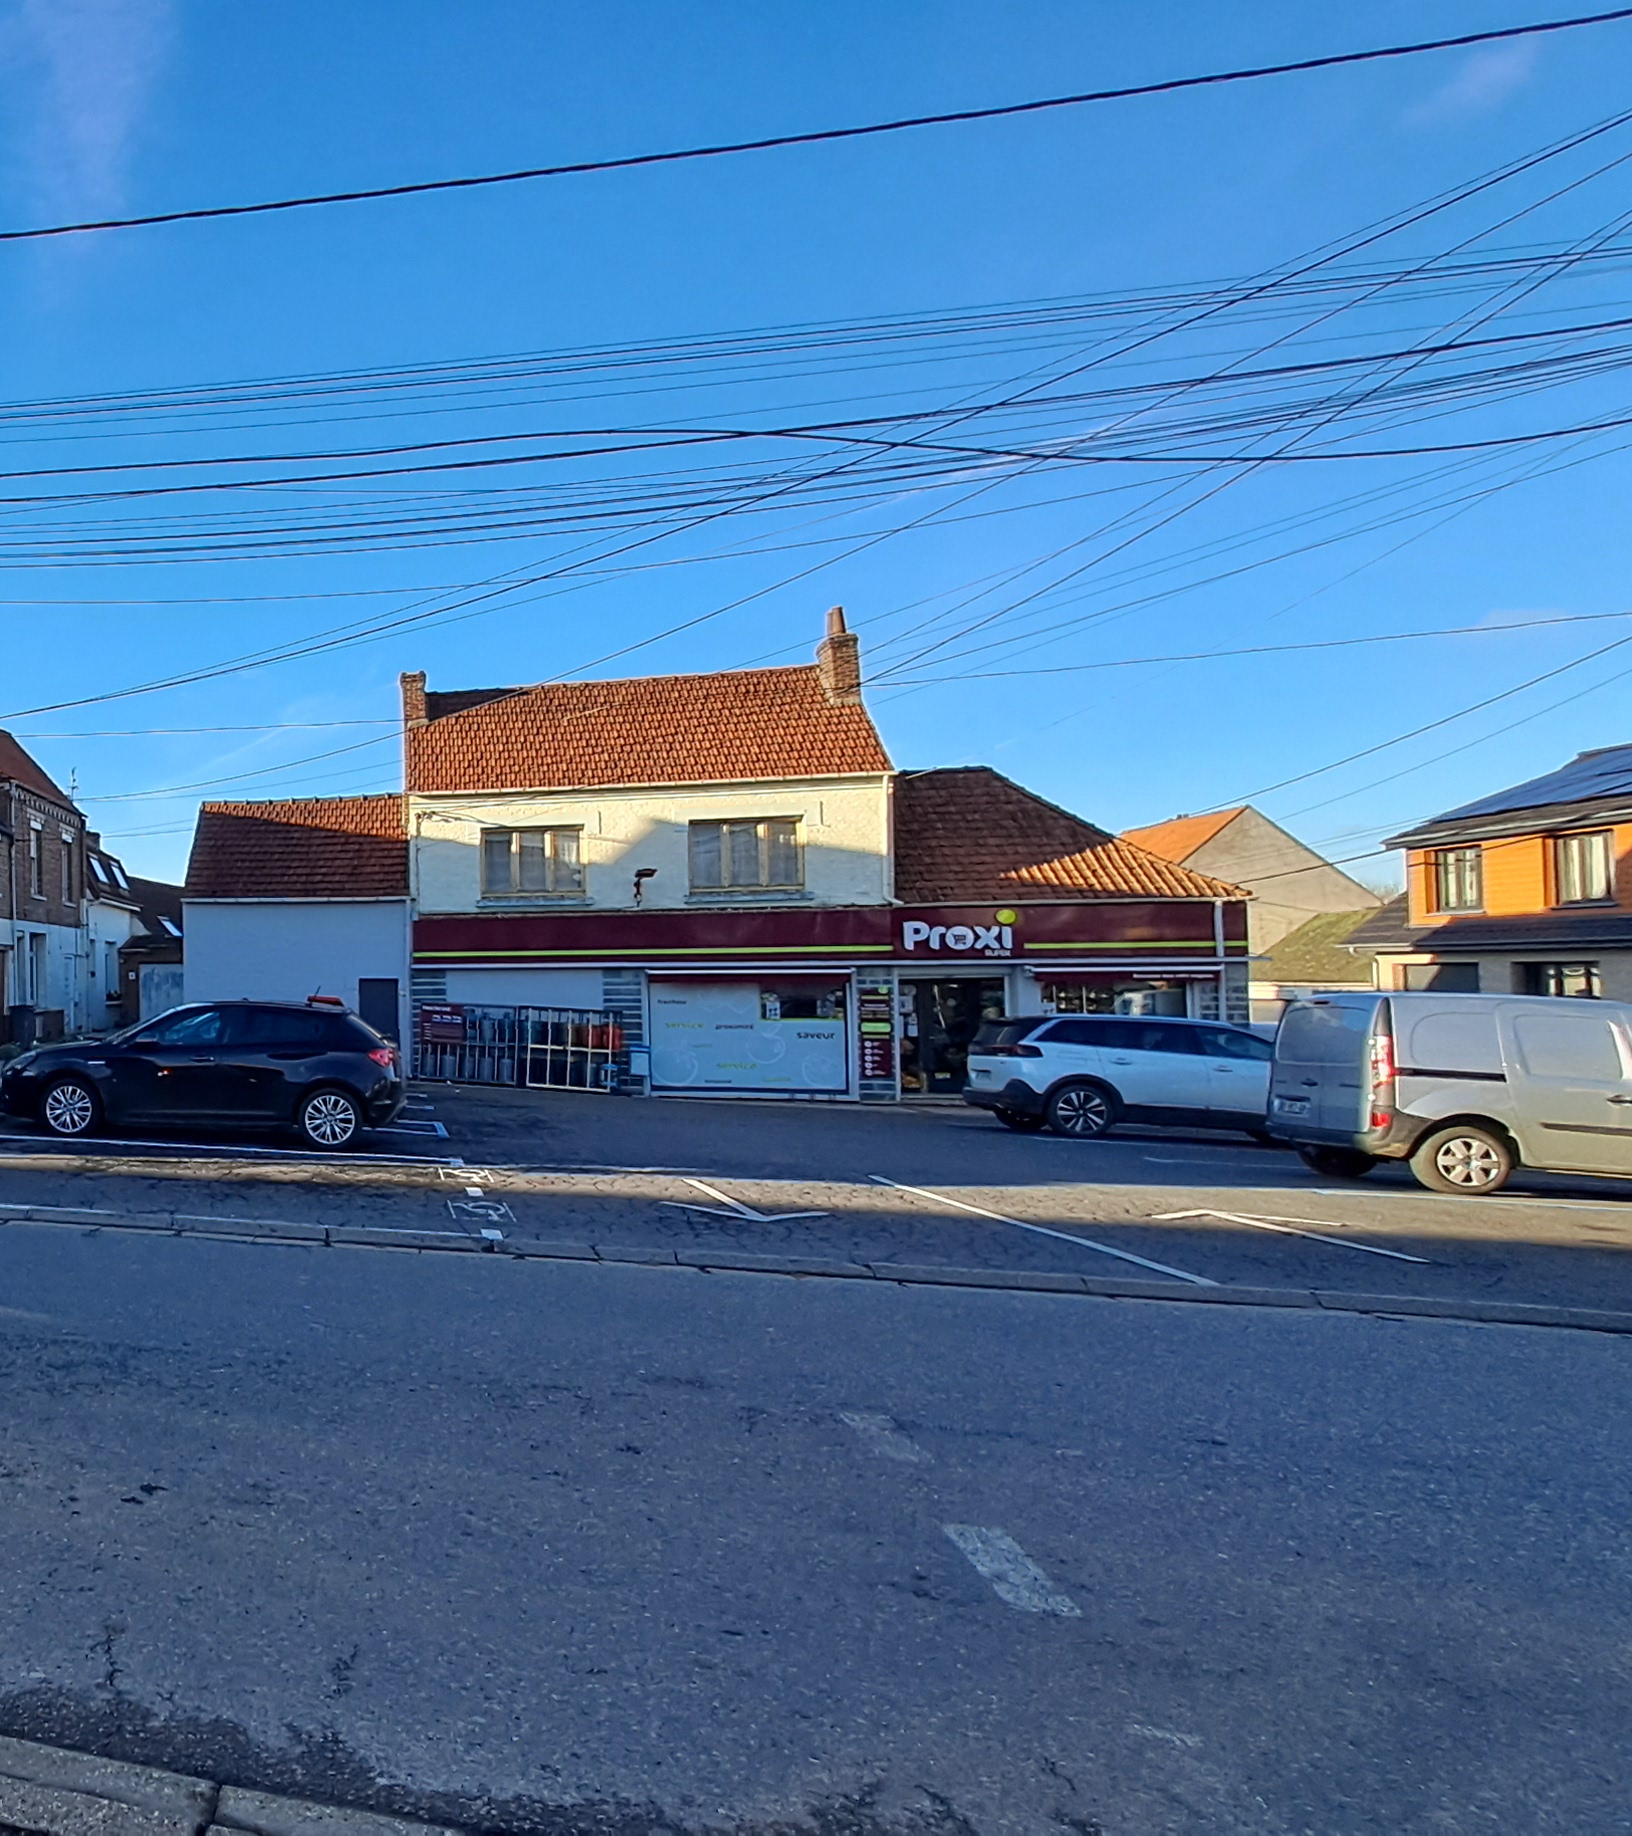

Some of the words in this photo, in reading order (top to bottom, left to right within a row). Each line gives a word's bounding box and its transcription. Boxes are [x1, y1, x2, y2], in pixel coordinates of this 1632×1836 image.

[903, 909, 1016, 951] Proxi
[796, 1031, 835, 1039] saveur
[717, 1062, 757, 1070] service
